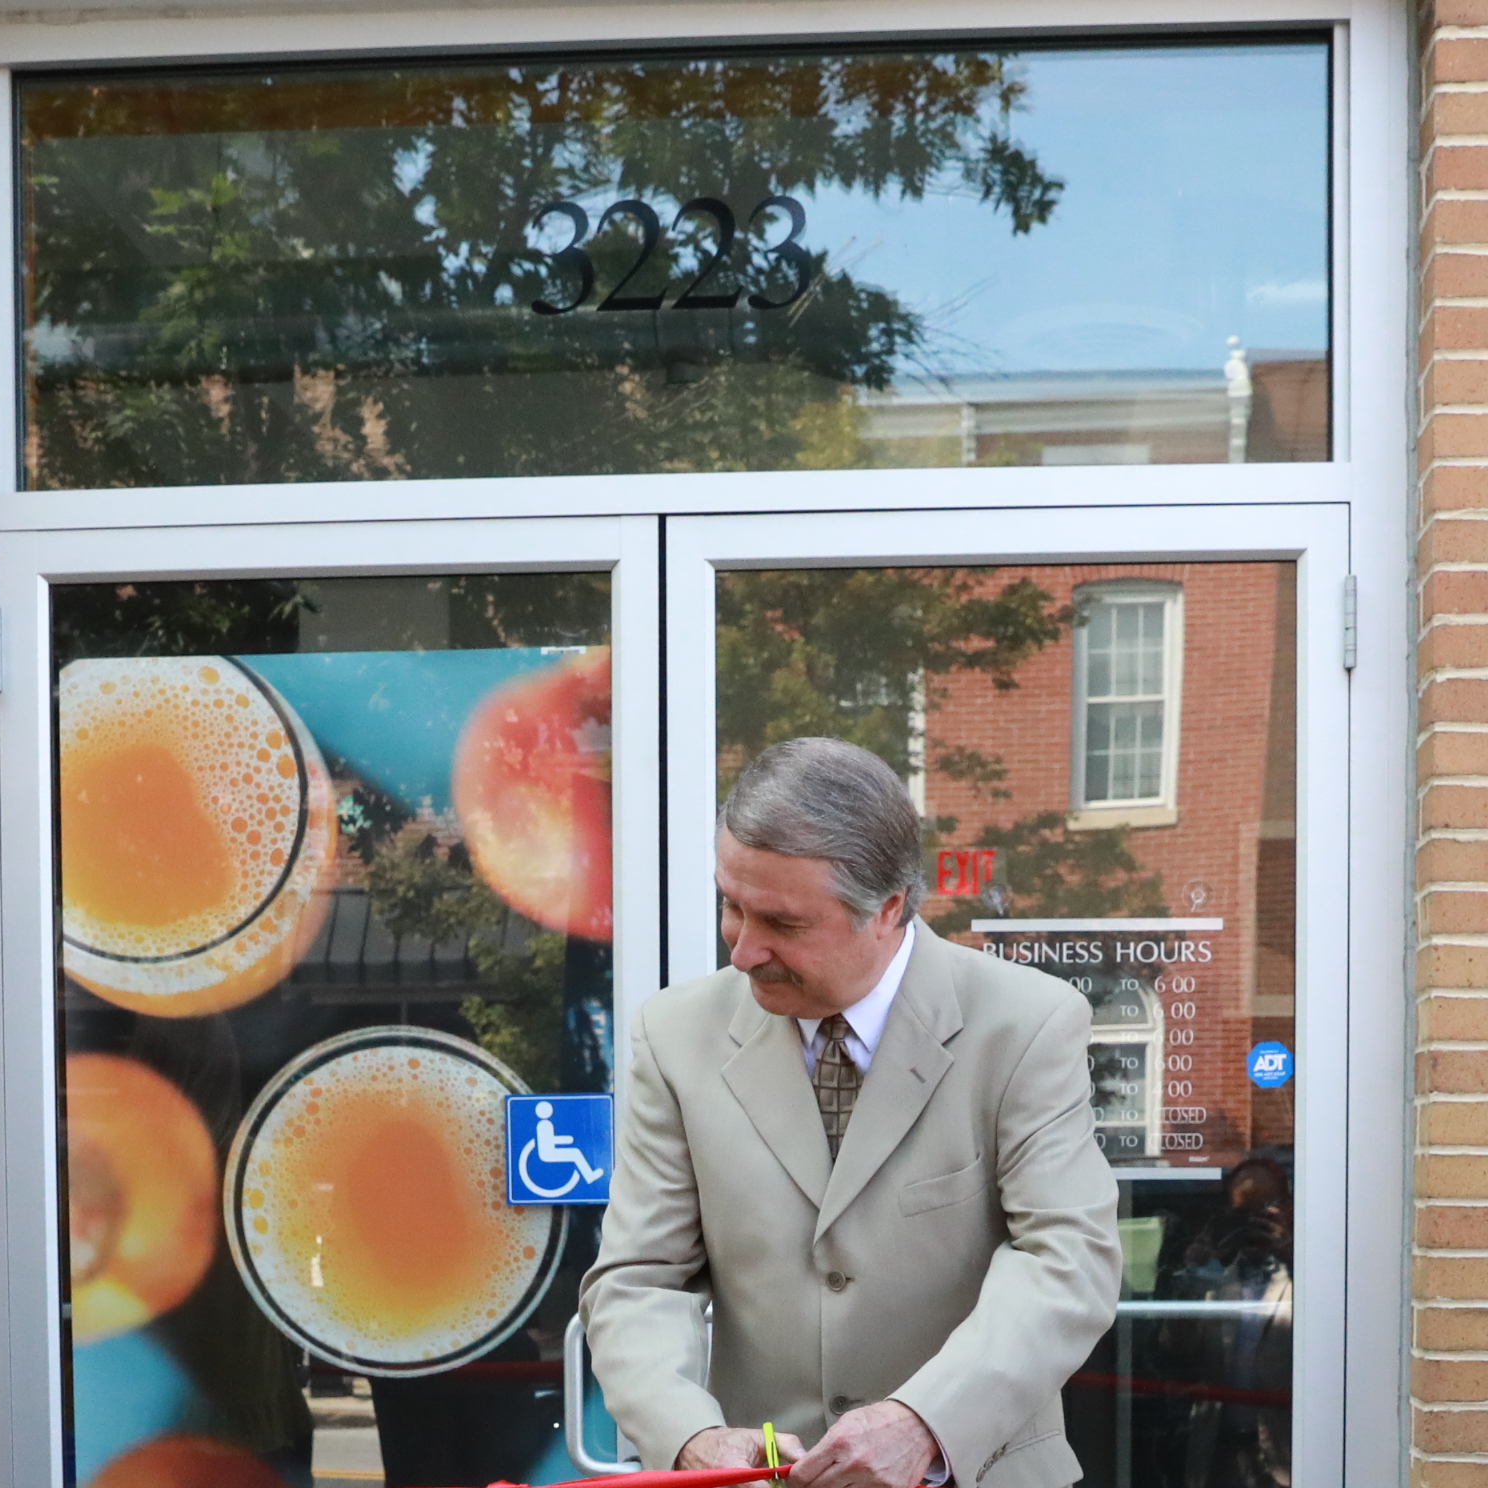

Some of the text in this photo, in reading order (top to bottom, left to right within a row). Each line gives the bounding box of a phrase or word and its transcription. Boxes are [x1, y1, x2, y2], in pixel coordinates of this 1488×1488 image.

[531, 195, 812, 315] 3223
[937, 849, 997, 896] EXIT
[982, 940, 1212, 964] BUSINESS HOURS
[1119, 978, 1139, 991] TO
[1119, 1004, 1139, 1017] TO
[1119, 1031, 1139, 1044] TO
[1119, 1057, 1139, 1070] TO
[1253, 1053, 1287, 1072] ADT
[1119, 1082, 1139, 1095] TO
[1119, 1109, 1139, 1121] TO
[1153, 1106, 1207, 1124] CLOSED
[1119, 1135, 1139, 1148] TO
[1151, 1132, 1204, 1150] CLOSED
